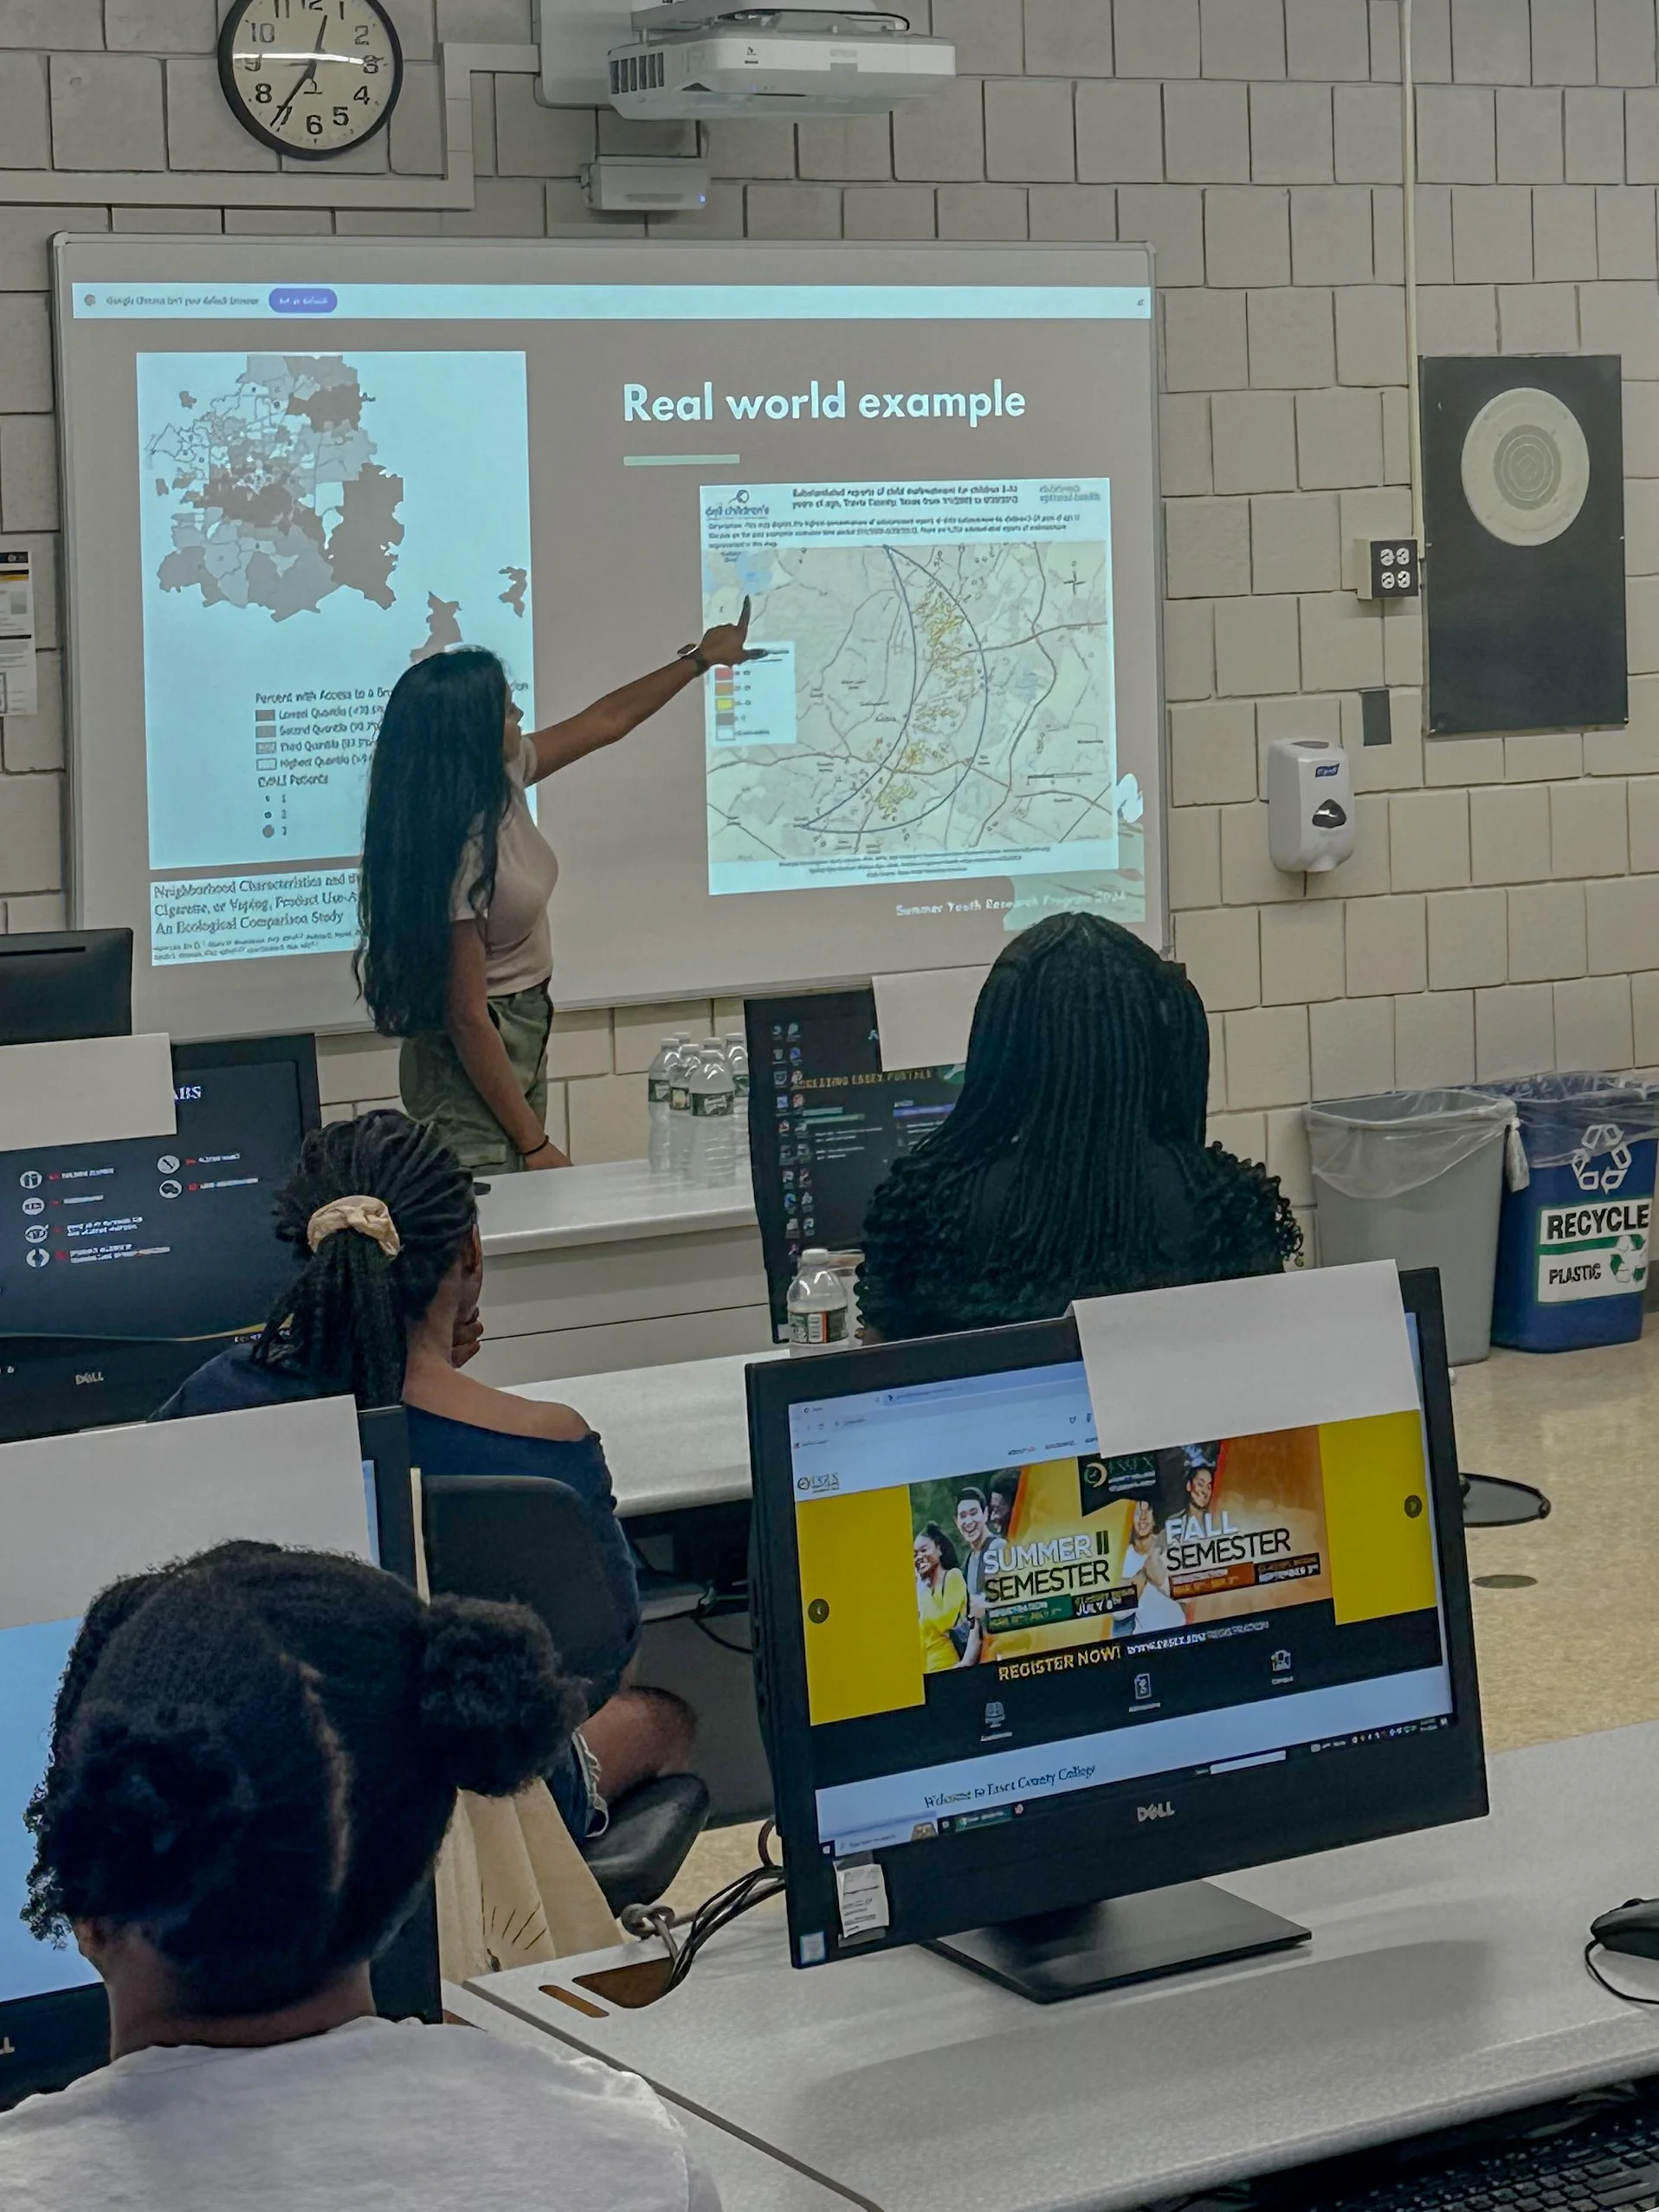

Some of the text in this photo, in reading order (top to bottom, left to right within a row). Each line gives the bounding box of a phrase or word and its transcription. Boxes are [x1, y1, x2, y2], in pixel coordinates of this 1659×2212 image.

[251, 23, 275, 43] 10
[354, 25, 370, 45] 2
[255, 82, 273, 103] 8
[353, 85, 370, 105] 4
[306, 114, 323, 134] 6
[332, 106, 349, 126] 5
[623, 378, 1026, 428] Real world example
[154, 881, 236, 900] Neighborhood
[895, 904, 943, 916] Summer
[947, 900, 981, 913] Youth
[156, 909, 344, 935] An Ecological Comparison Study
[1546, 1203, 1650, 1240] RECYCLE
[1549, 1262, 1602, 1285] PLASTIC
[1165, 1510, 1239, 1545] FALL
[984, 1534, 1094, 1574] SUMMER
[1166, 1527, 1292, 1571] SEMESTER
[984, 1559, 1111, 1603] SEMESTER
[1075, 1600, 1105, 1616] JULY
[998, 1654, 1075, 1681] REGISTER
[1077, 1646, 1122, 1666] NOW!
[1137, 1801, 1175, 1822] DELL
